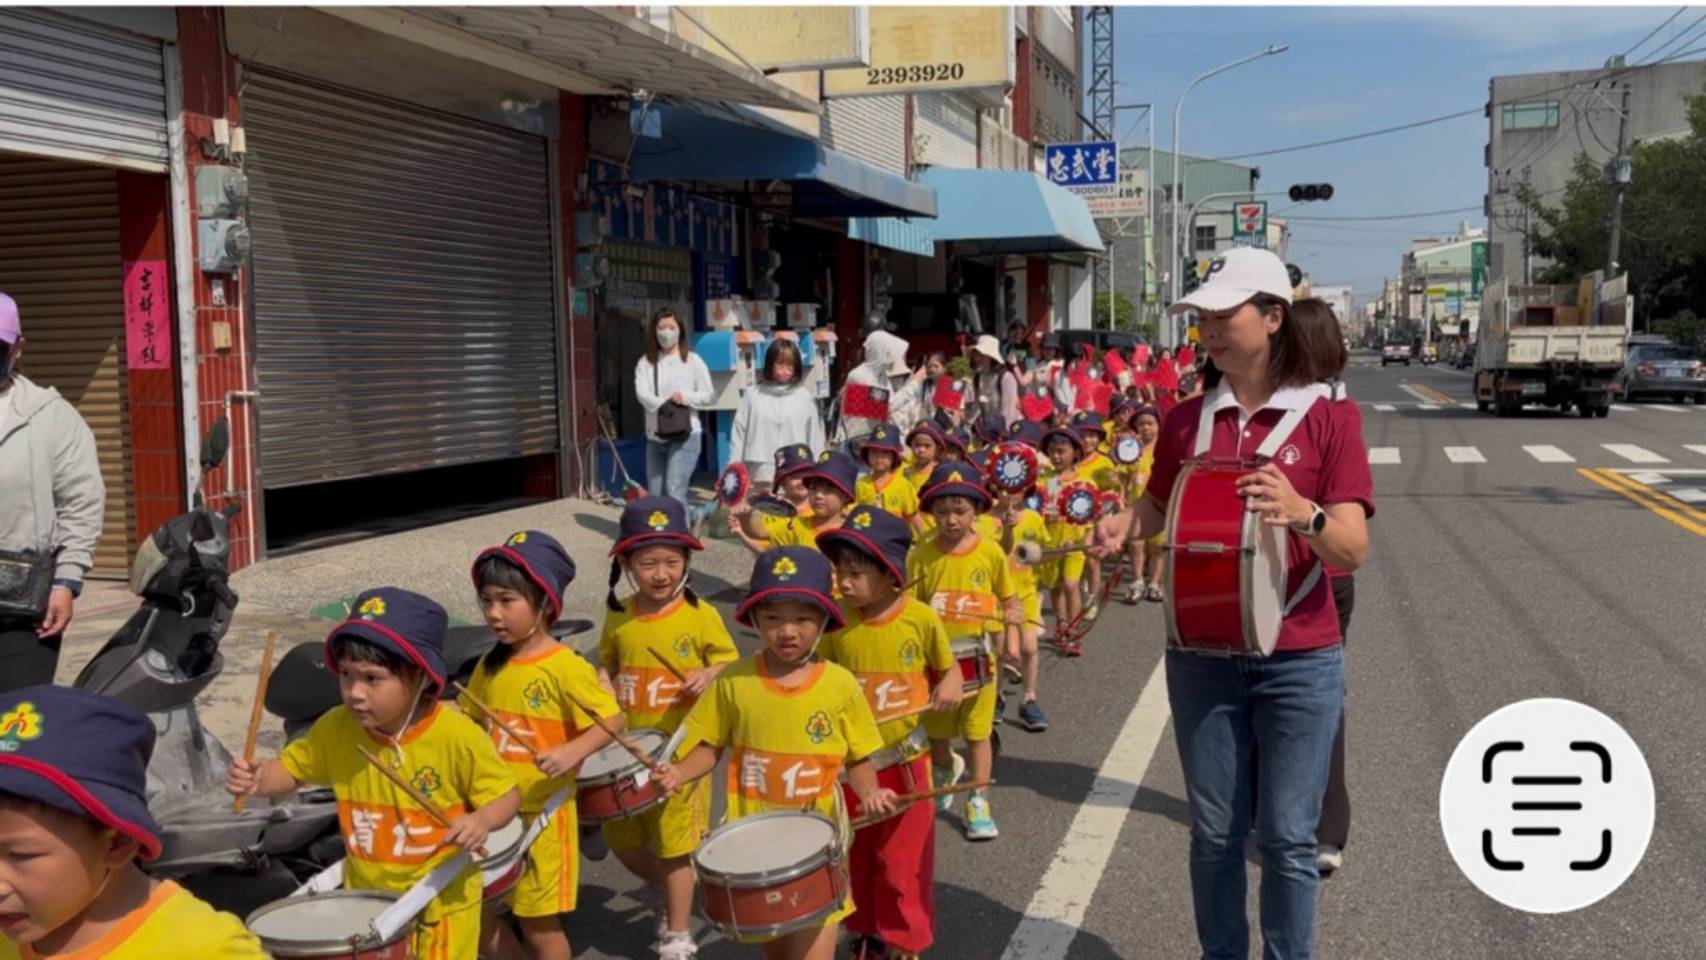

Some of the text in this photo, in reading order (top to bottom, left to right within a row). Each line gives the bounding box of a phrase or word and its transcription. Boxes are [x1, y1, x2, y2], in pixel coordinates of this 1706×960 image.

[867, 63, 964, 85] 2393920
[1049, 148, 1115, 181] 忠武堂
[1201, 257, 1226, 284] P
[617, 673, 683, 708] 育仁
[860, 679, 910, 712] 仁
[486, 717, 536, 754] 仁
[742, 755, 821, 798] 育仁
[349, 808, 438, 857] 育仁
